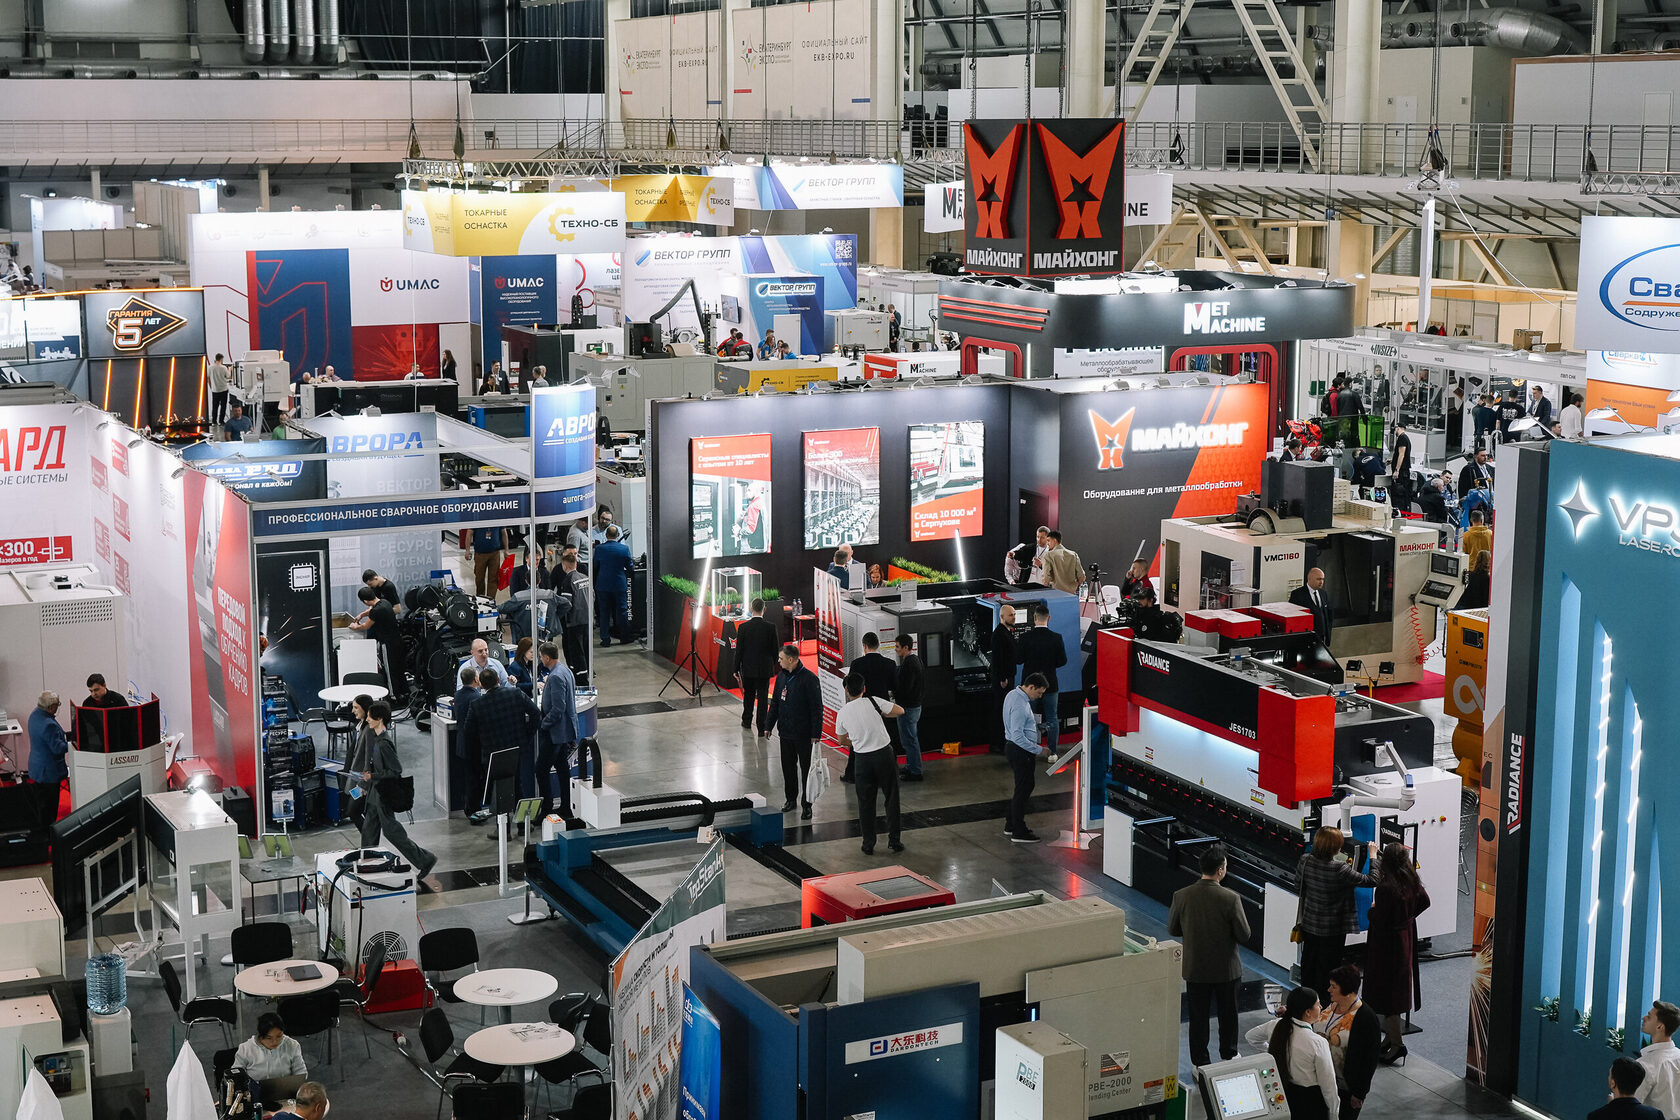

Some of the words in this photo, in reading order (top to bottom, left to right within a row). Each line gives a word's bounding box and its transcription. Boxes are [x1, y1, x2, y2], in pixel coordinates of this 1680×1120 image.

[801, 37, 849, 49] ОФИЦИАЛЬНЫЙ
[850, 36, 869, 46] САЙТ
[813, 52, 855, 62] EKB-EXPO.RU
[808, 178, 846, 187] ВЕКТОР
[846, 177, 875, 186] ГРУПП
[635, 188, 668, 196] ТОКАРНЫЕ
[635, 198, 668, 206] ОСНАСТКА
[464, 208, 508, 217] ТОКАРНЫЕ
[464, 221, 508, 230] ОСНАСТКА
[561, 219, 619, 228] ТЕХНО-СБ
[654, 250, 695, 260] ВЕКТОР
[696, 249, 731, 259] ГРУПП
[966, 248, 1024, 269] МАЙХОНГ
[1033, 249, 1119, 269] МАЙХОНГ
[396, 278, 440, 290] UMAC
[507, 277, 544, 288] UMAC
[794, 283, 816, 291] ГРУПП
[109, 309, 153, 319] ГАРАНТИЯ
[116, 317, 144, 347] 5
[144, 317, 162, 326] ЛЕТ
[1374, 344, 1394, 357] INSIZE
[1079, 358, 1154, 368] Металлообрабатывающее
[1131, 421, 1249, 451] МАЙХОНГ
[326, 431, 423, 454] ВРОРА
[15, 473, 68, 485] СИСТЕМЫ
[377, 478, 433, 493] ВЕКТОР
[1083, 488, 1146, 499] Оборудование
[1146, 486, 1163, 496] для
[1165, 480, 1243, 492] металлообработки
[268, 508, 378, 525] ПРОФЕССИОНАЛЬНОЕ
[380, 504, 439, 517] СВАРОЧНОЕ
[441, 500, 519, 514] ОБОРУДОВАНИЕ
[914, 512, 938, 520] Склад
[940, 510, 949, 518] 10
[950, 508, 965, 517] 000
[380, 539, 433, 554] РЕСУРС
[1399, 542, 1435, 552] МАЙХОНГ
[380, 555, 433, 568] СИСТЕМА
[1137, 650, 1170, 673] RADIANCE
[1229, 722, 1256, 740] JES1703
[110, 754, 139, 766] LASSARD
[1507, 732, 1523, 835] RADIANCE
[890, 1030, 939, 1049] 大东科技
[890, 1040, 939, 1053] DARDONTECH
[1111, 1087, 1132, 1096] Center
